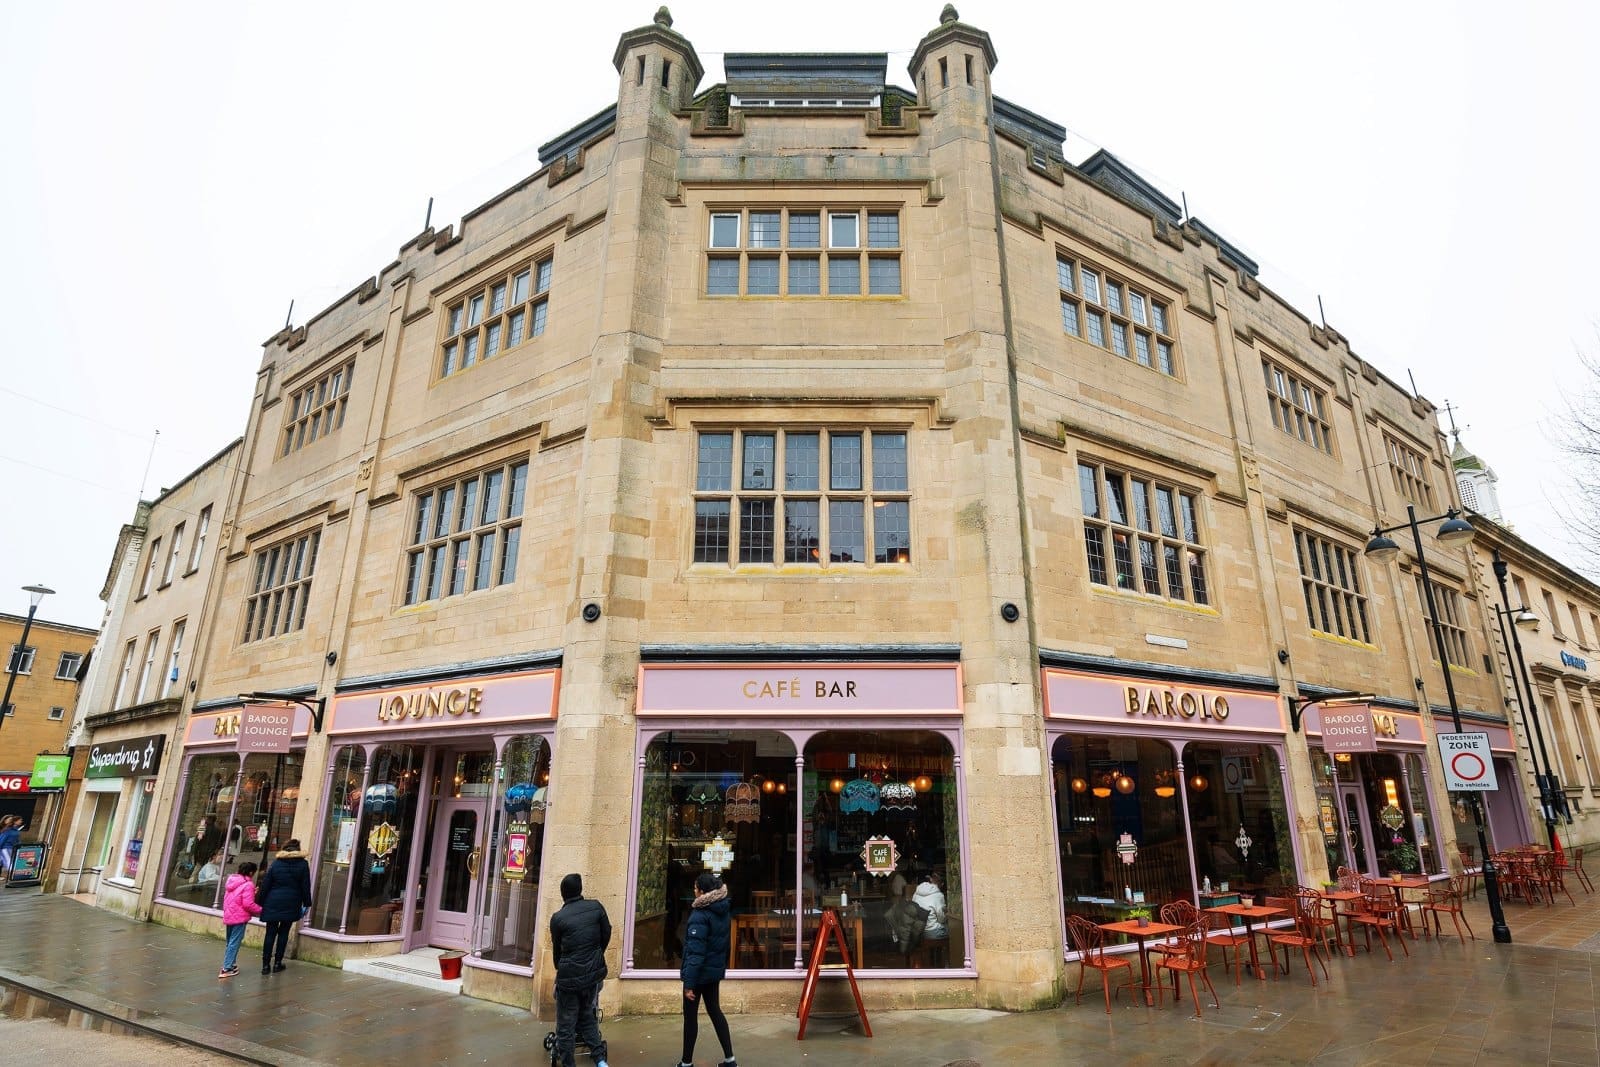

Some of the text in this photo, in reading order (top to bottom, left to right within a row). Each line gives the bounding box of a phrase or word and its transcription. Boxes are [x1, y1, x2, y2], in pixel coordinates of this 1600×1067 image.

[742, 677, 857, 699] CAFÉ BAR
[378, 687, 484, 721] LOUNGE
[1123, 687, 1230, 720] BAROLO
[247, 714, 289, 725] BAROLO
[1324, 714, 1365, 724] BAROLO
[244, 726, 289, 736] LOUNGE
[1325, 726, 1368, 736] LOUNGE
[1449, 742, 1480, 750] ZONE
[89, 745, 140, 772] Superdrug
[874, 856, 886, 864] BAR
